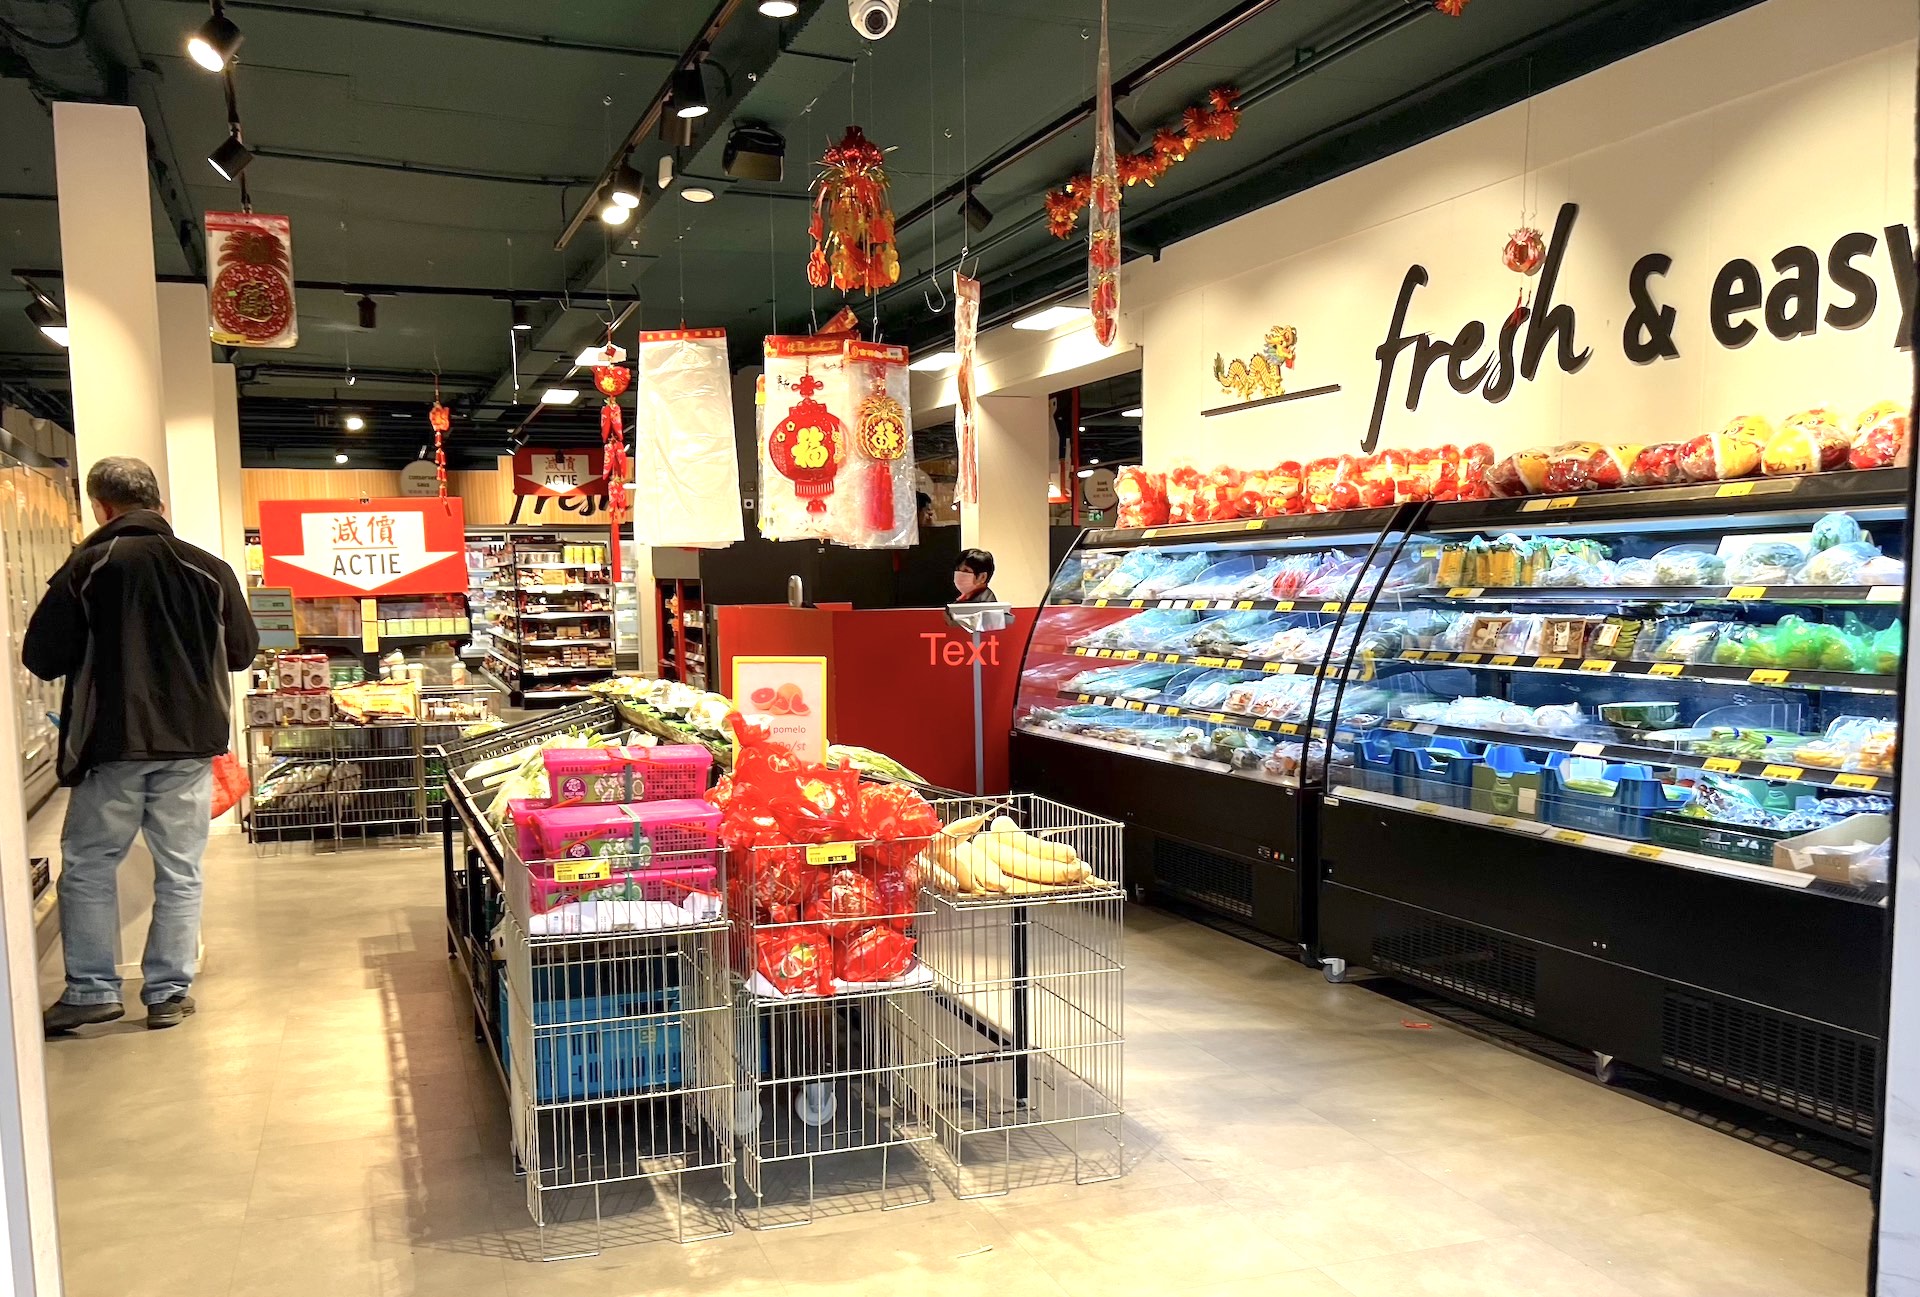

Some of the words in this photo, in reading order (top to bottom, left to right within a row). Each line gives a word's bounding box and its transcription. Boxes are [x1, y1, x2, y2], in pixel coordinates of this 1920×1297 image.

[1360, 202, 1593, 454] fresh
[1622, 252, 1680, 366] &
[791, 426, 829, 468] 福
[545, 474, 578, 485] ACTIE
[331, 515, 396, 546] 減價
[332, 553, 401, 576] ACTIE
[773, 725, 806, 734] pomelo
